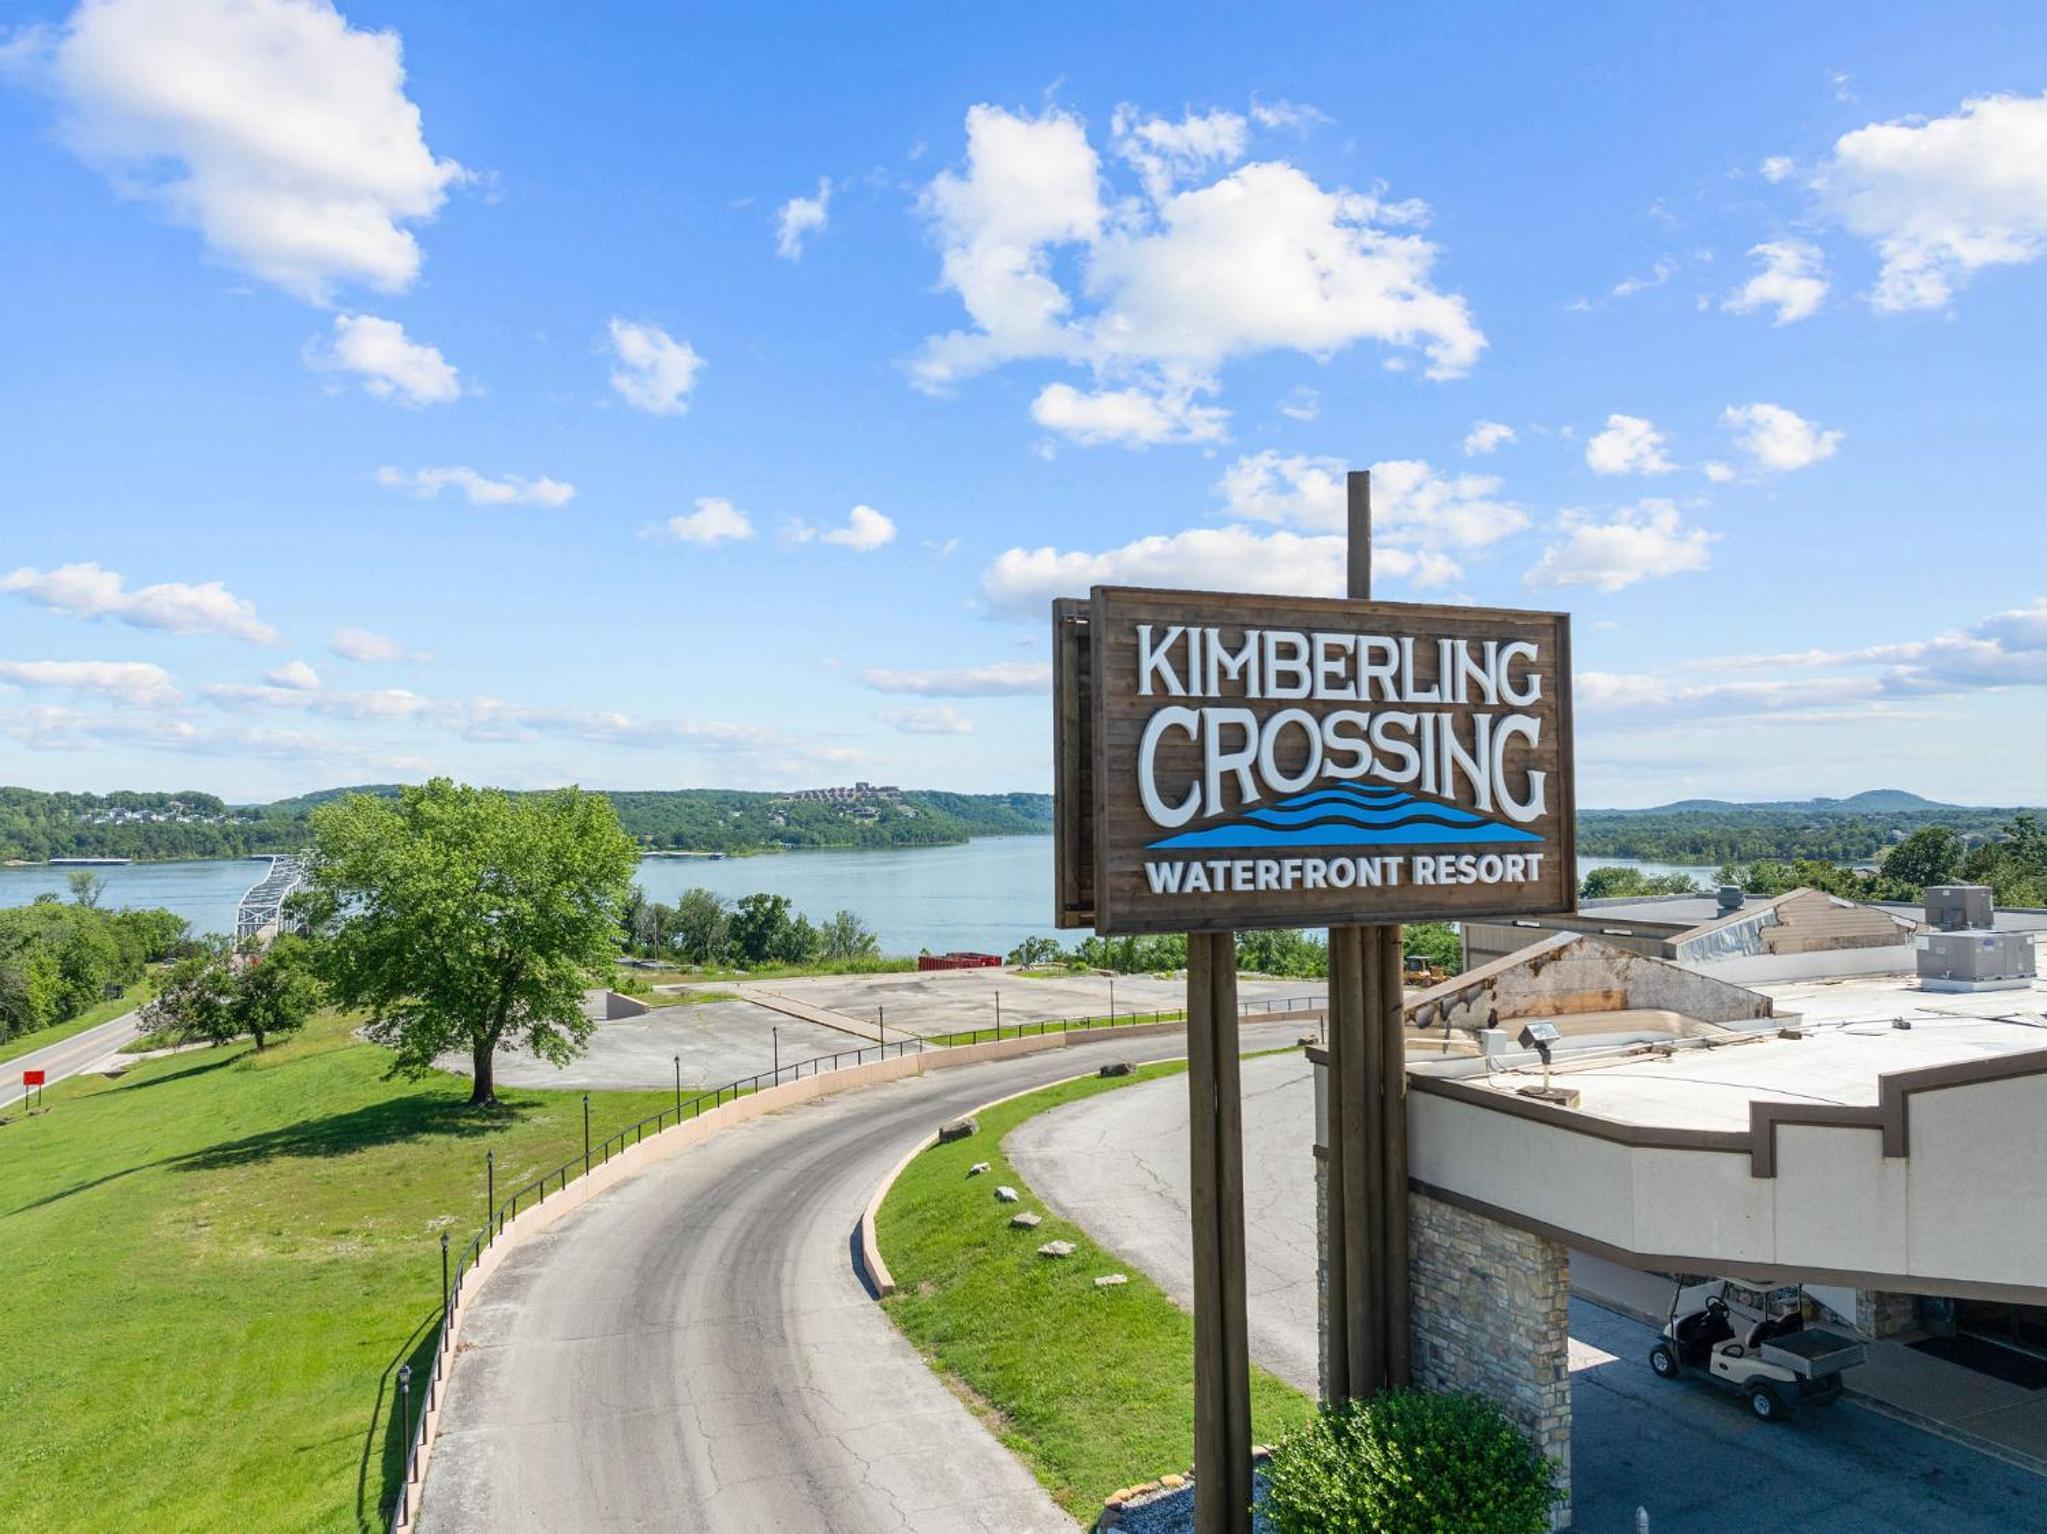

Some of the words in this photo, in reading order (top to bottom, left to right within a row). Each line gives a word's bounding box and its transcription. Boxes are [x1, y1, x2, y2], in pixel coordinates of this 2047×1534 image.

[1137, 625, 1541, 705] KIMBERLING
[1138, 706, 1547, 828] CROSSING
[1145, 857, 1404, 893] WATERFRONT
[1412, 853, 1544, 885] RESORT
